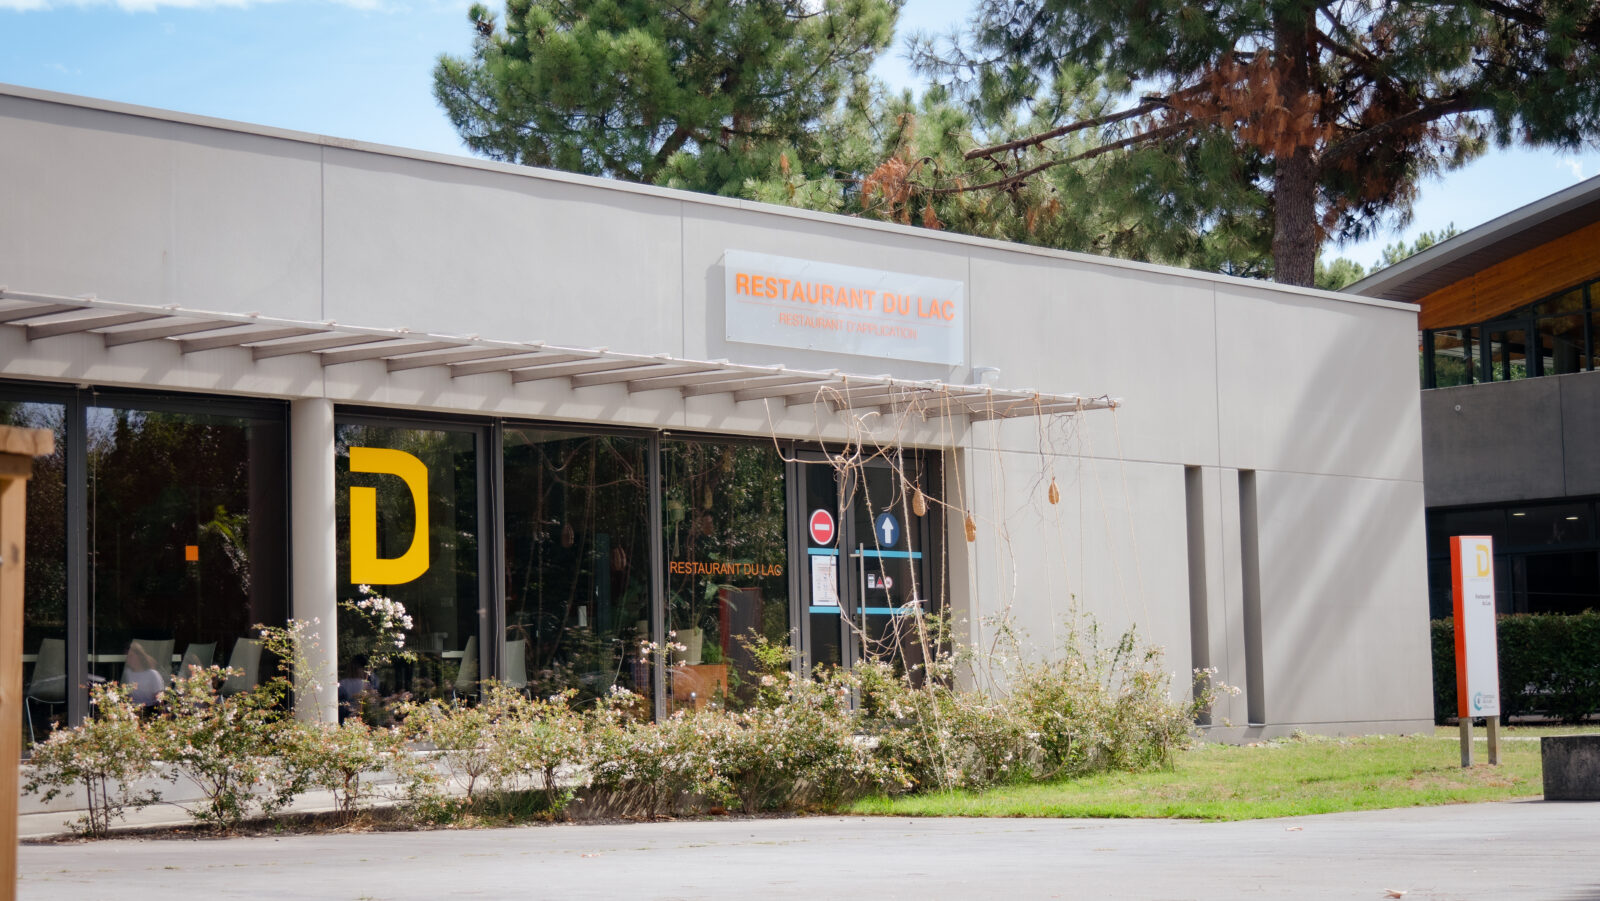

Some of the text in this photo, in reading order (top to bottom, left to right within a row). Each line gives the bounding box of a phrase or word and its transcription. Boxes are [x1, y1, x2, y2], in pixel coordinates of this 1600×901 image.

[735, 272, 955, 321] RESTAURANT DU LAC
[778, 312, 918, 340] RESTAURANT D'APPLICATION
[349, 446, 430, 585] D
[669, 561, 782, 576] RESTAURANT DU LAC
